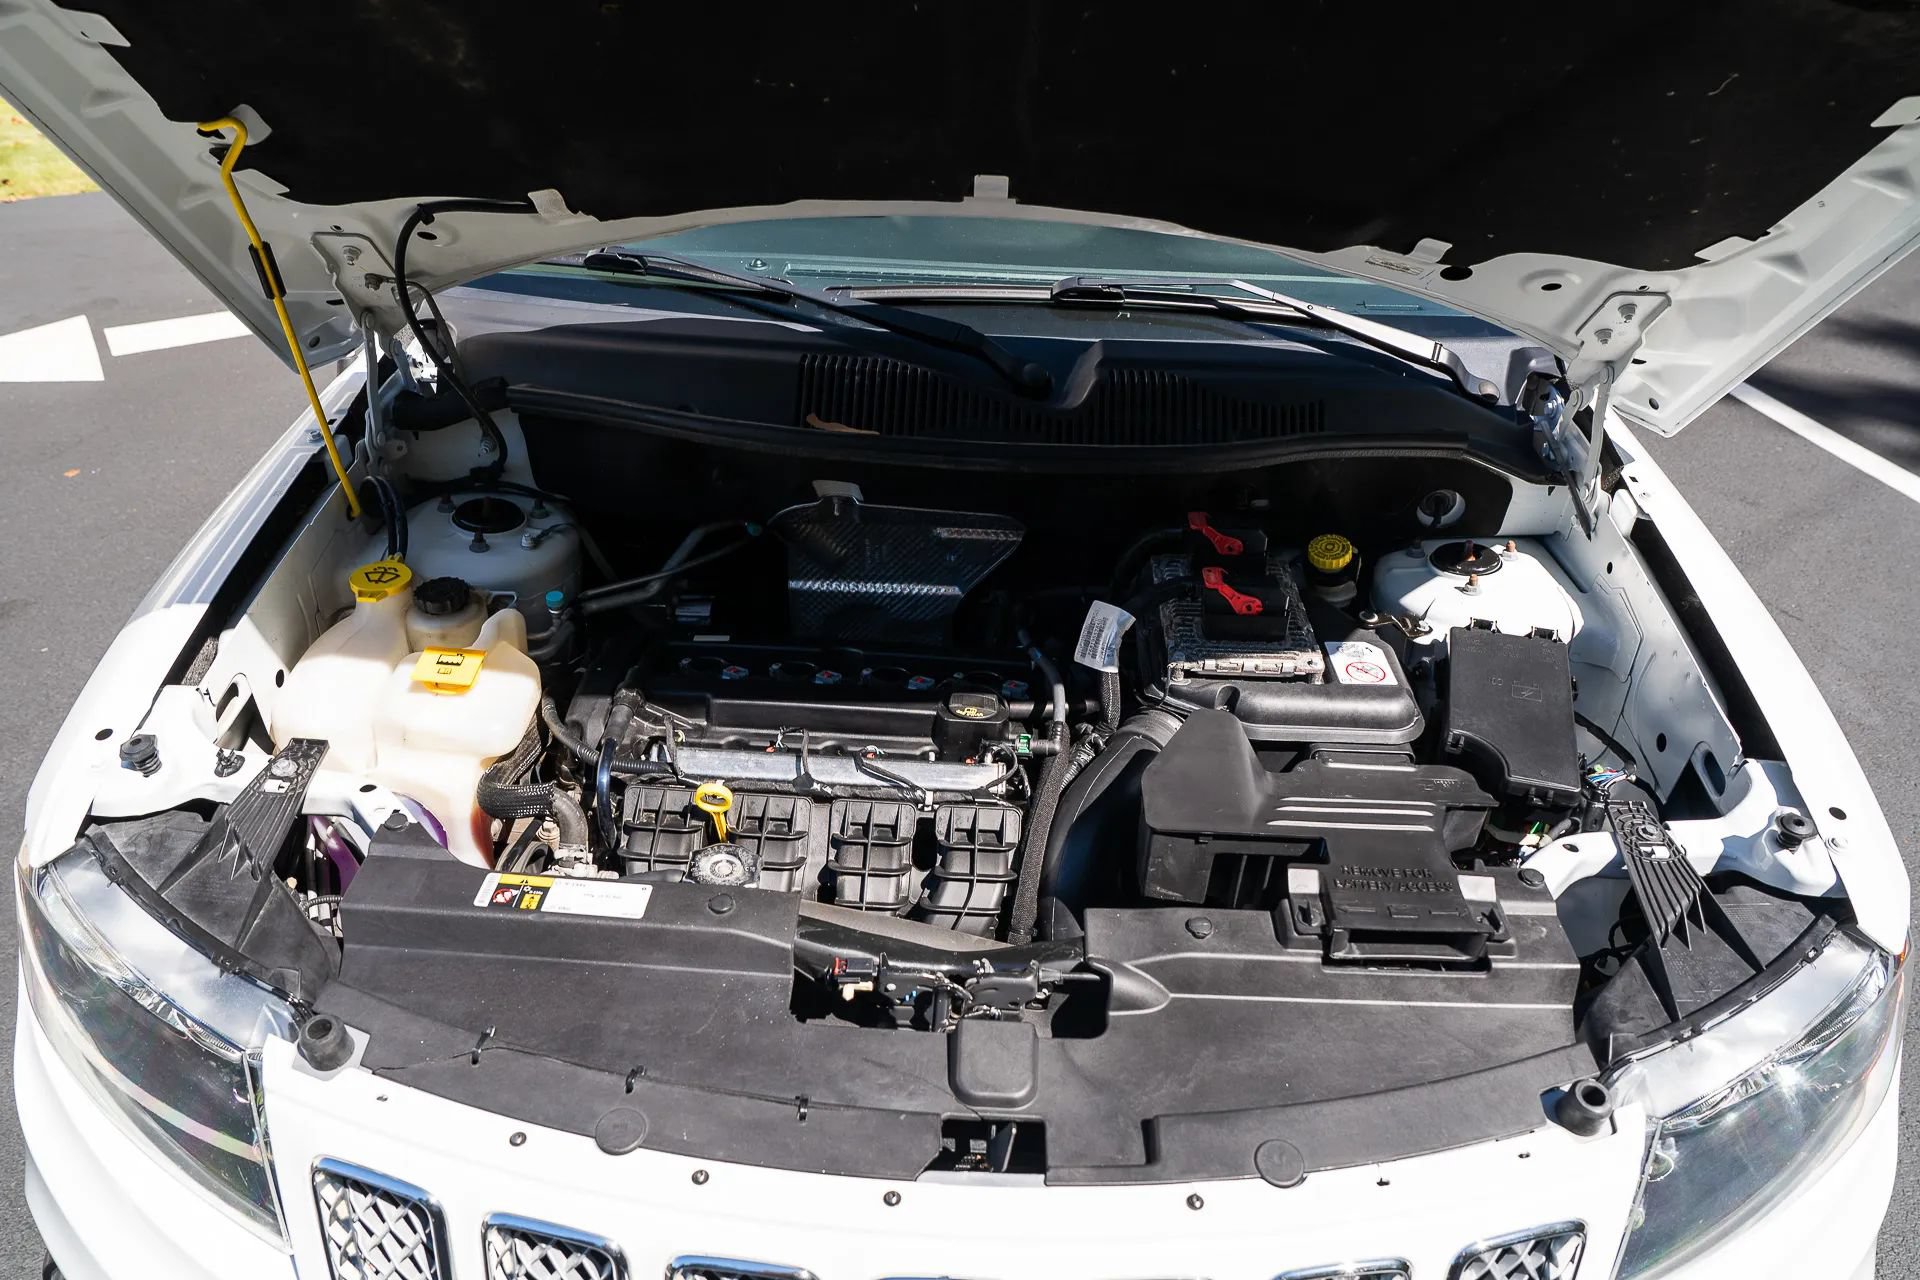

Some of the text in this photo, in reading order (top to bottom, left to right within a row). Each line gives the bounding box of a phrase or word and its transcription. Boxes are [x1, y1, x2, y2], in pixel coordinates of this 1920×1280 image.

[1340, 865, 1432, 879] REMOVE FOR
[1333, 878, 1454, 892] BATTERY ACCESS
